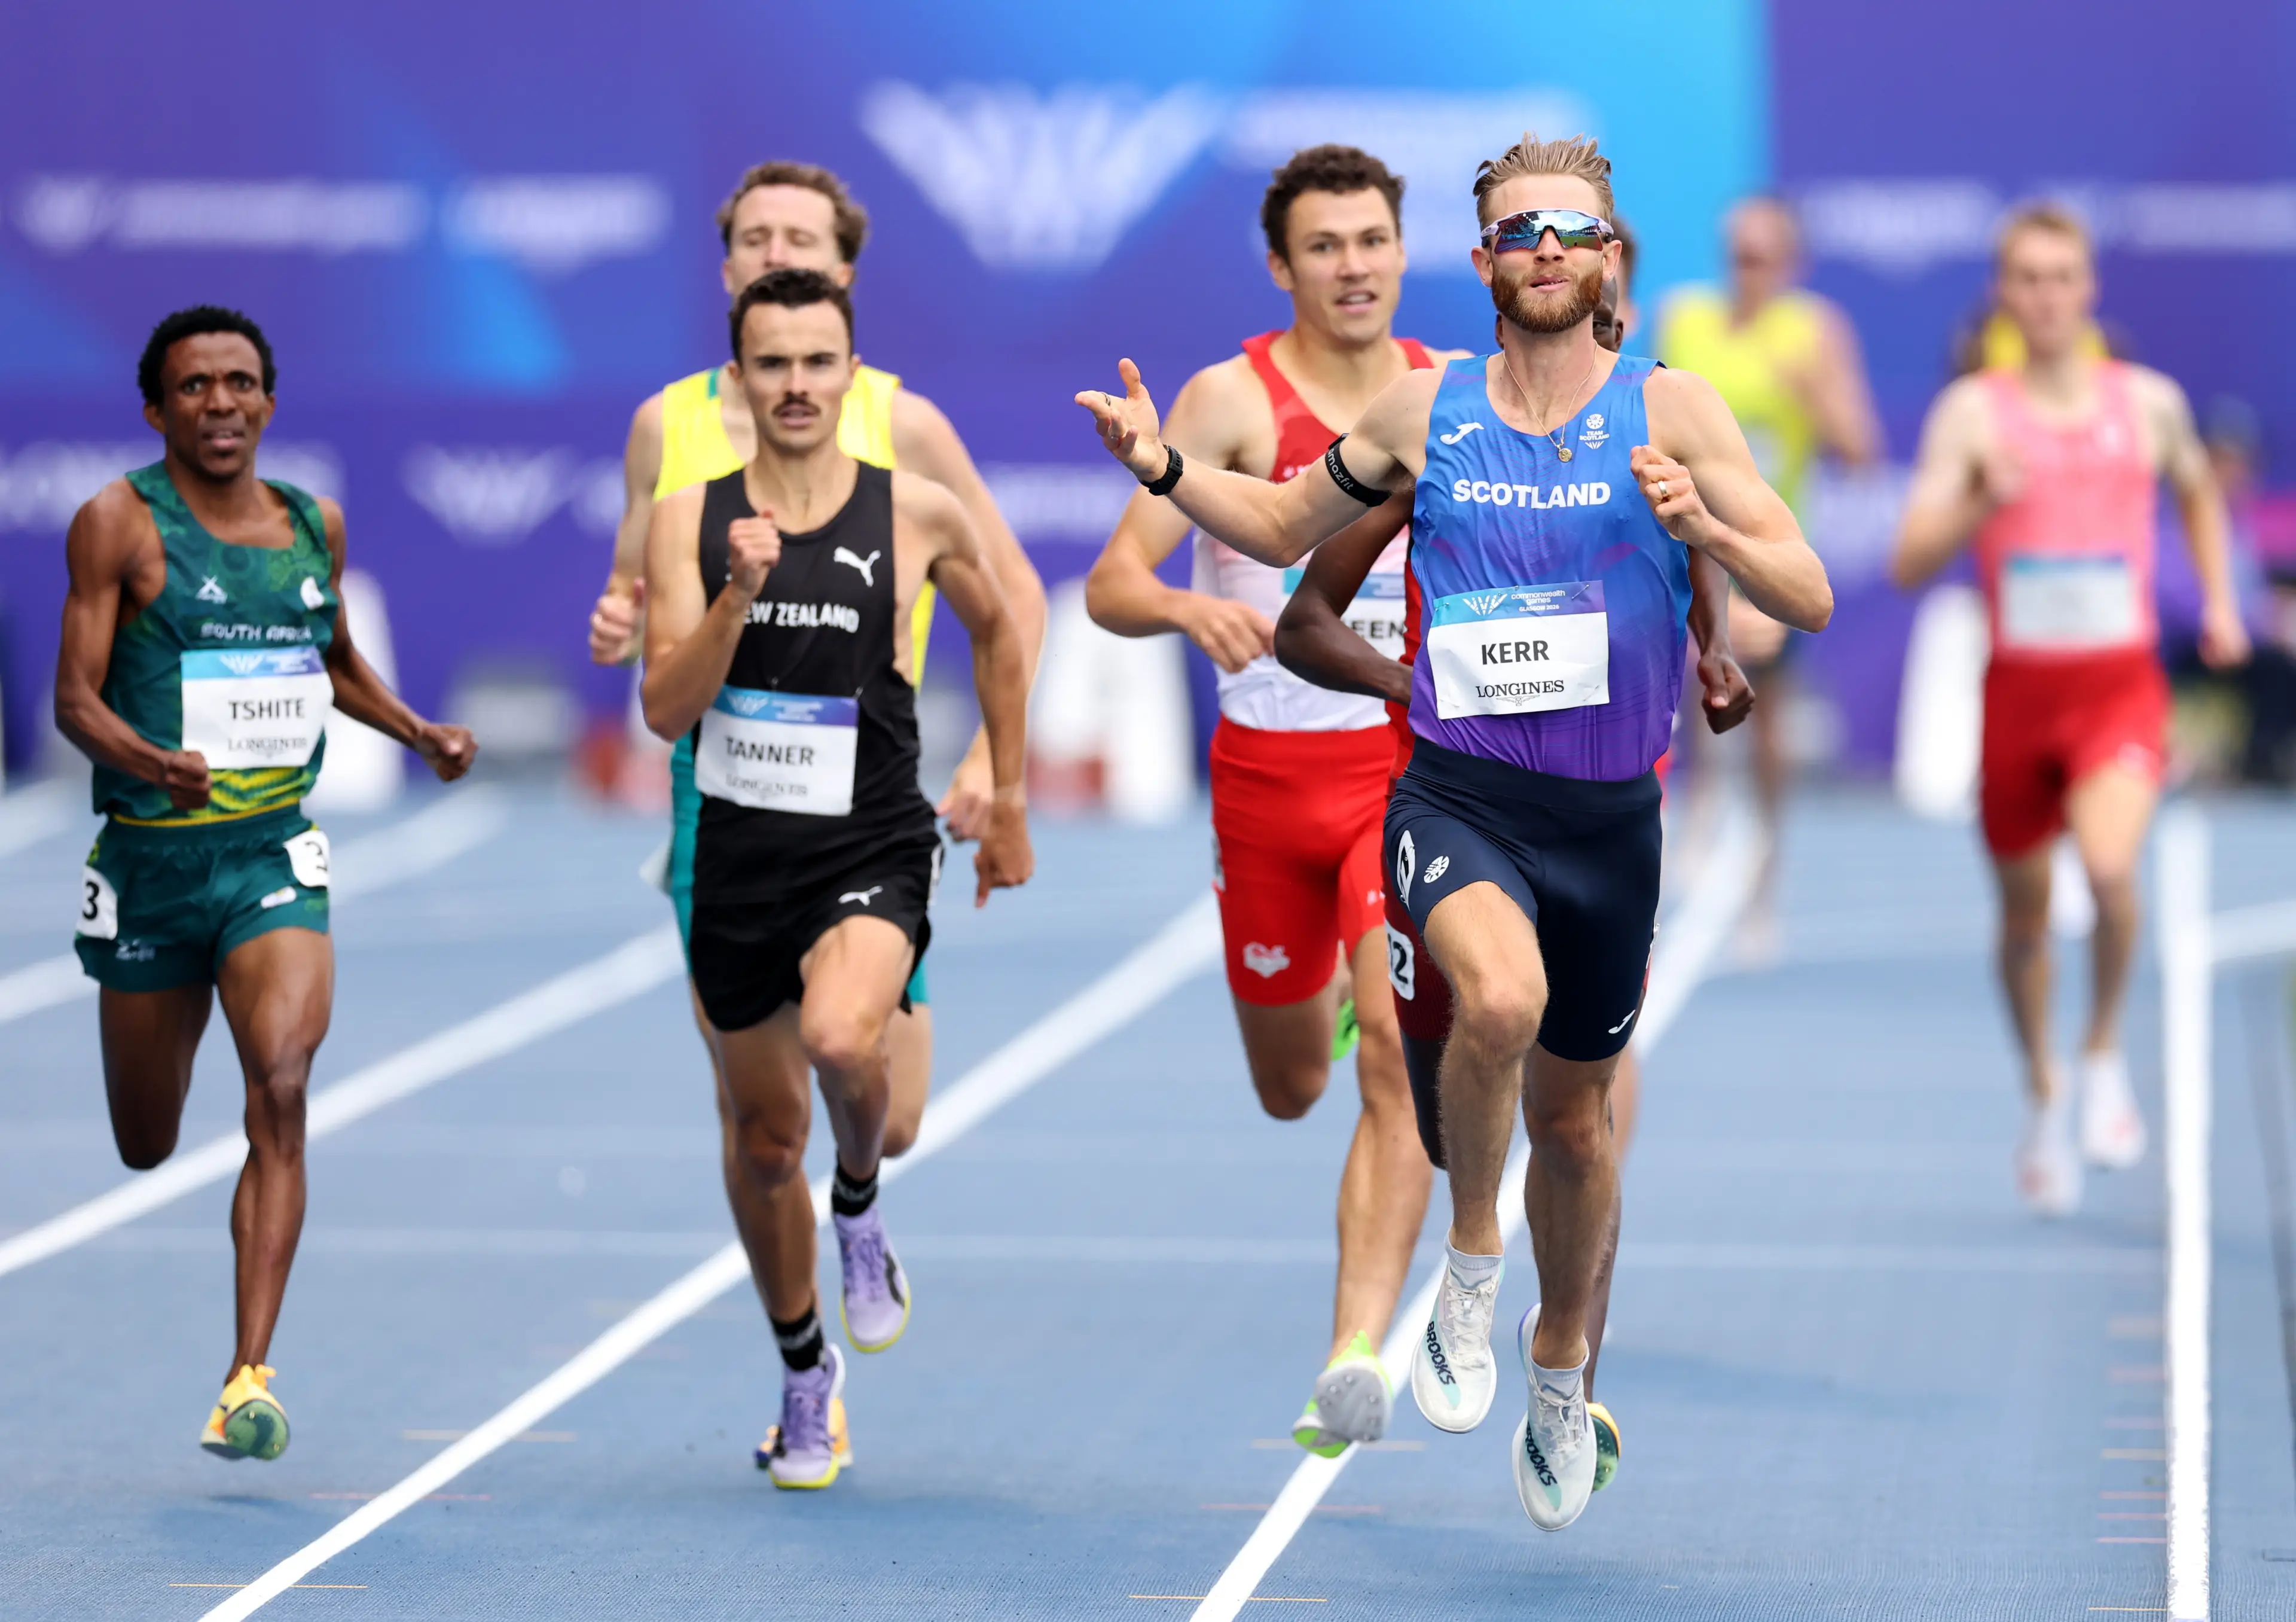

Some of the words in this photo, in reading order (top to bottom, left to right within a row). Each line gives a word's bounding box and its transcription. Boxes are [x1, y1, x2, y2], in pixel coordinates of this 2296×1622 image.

[1327, 448, 1354, 490] amazfit
[1452, 479, 1611, 509] SCOTLAND
[1511, 590, 1565, 600] commonwealth
[1526, 597, 1551, 606] games
[775, 602, 859, 633] ZEALAND
[1350, 620, 1405, 639] EEN
[200, 623, 261, 641] SOUTH
[1482, 641, 1550, 665] KERR
[1475, 680, 1564, 697] LONGINES
[228, 698, 305, 721] TSHITE
[725, 736, 815, 767] TANNER
[83, 881, 100, 920] 3
[1427, 1321, 1457, 1385] BROOKS
